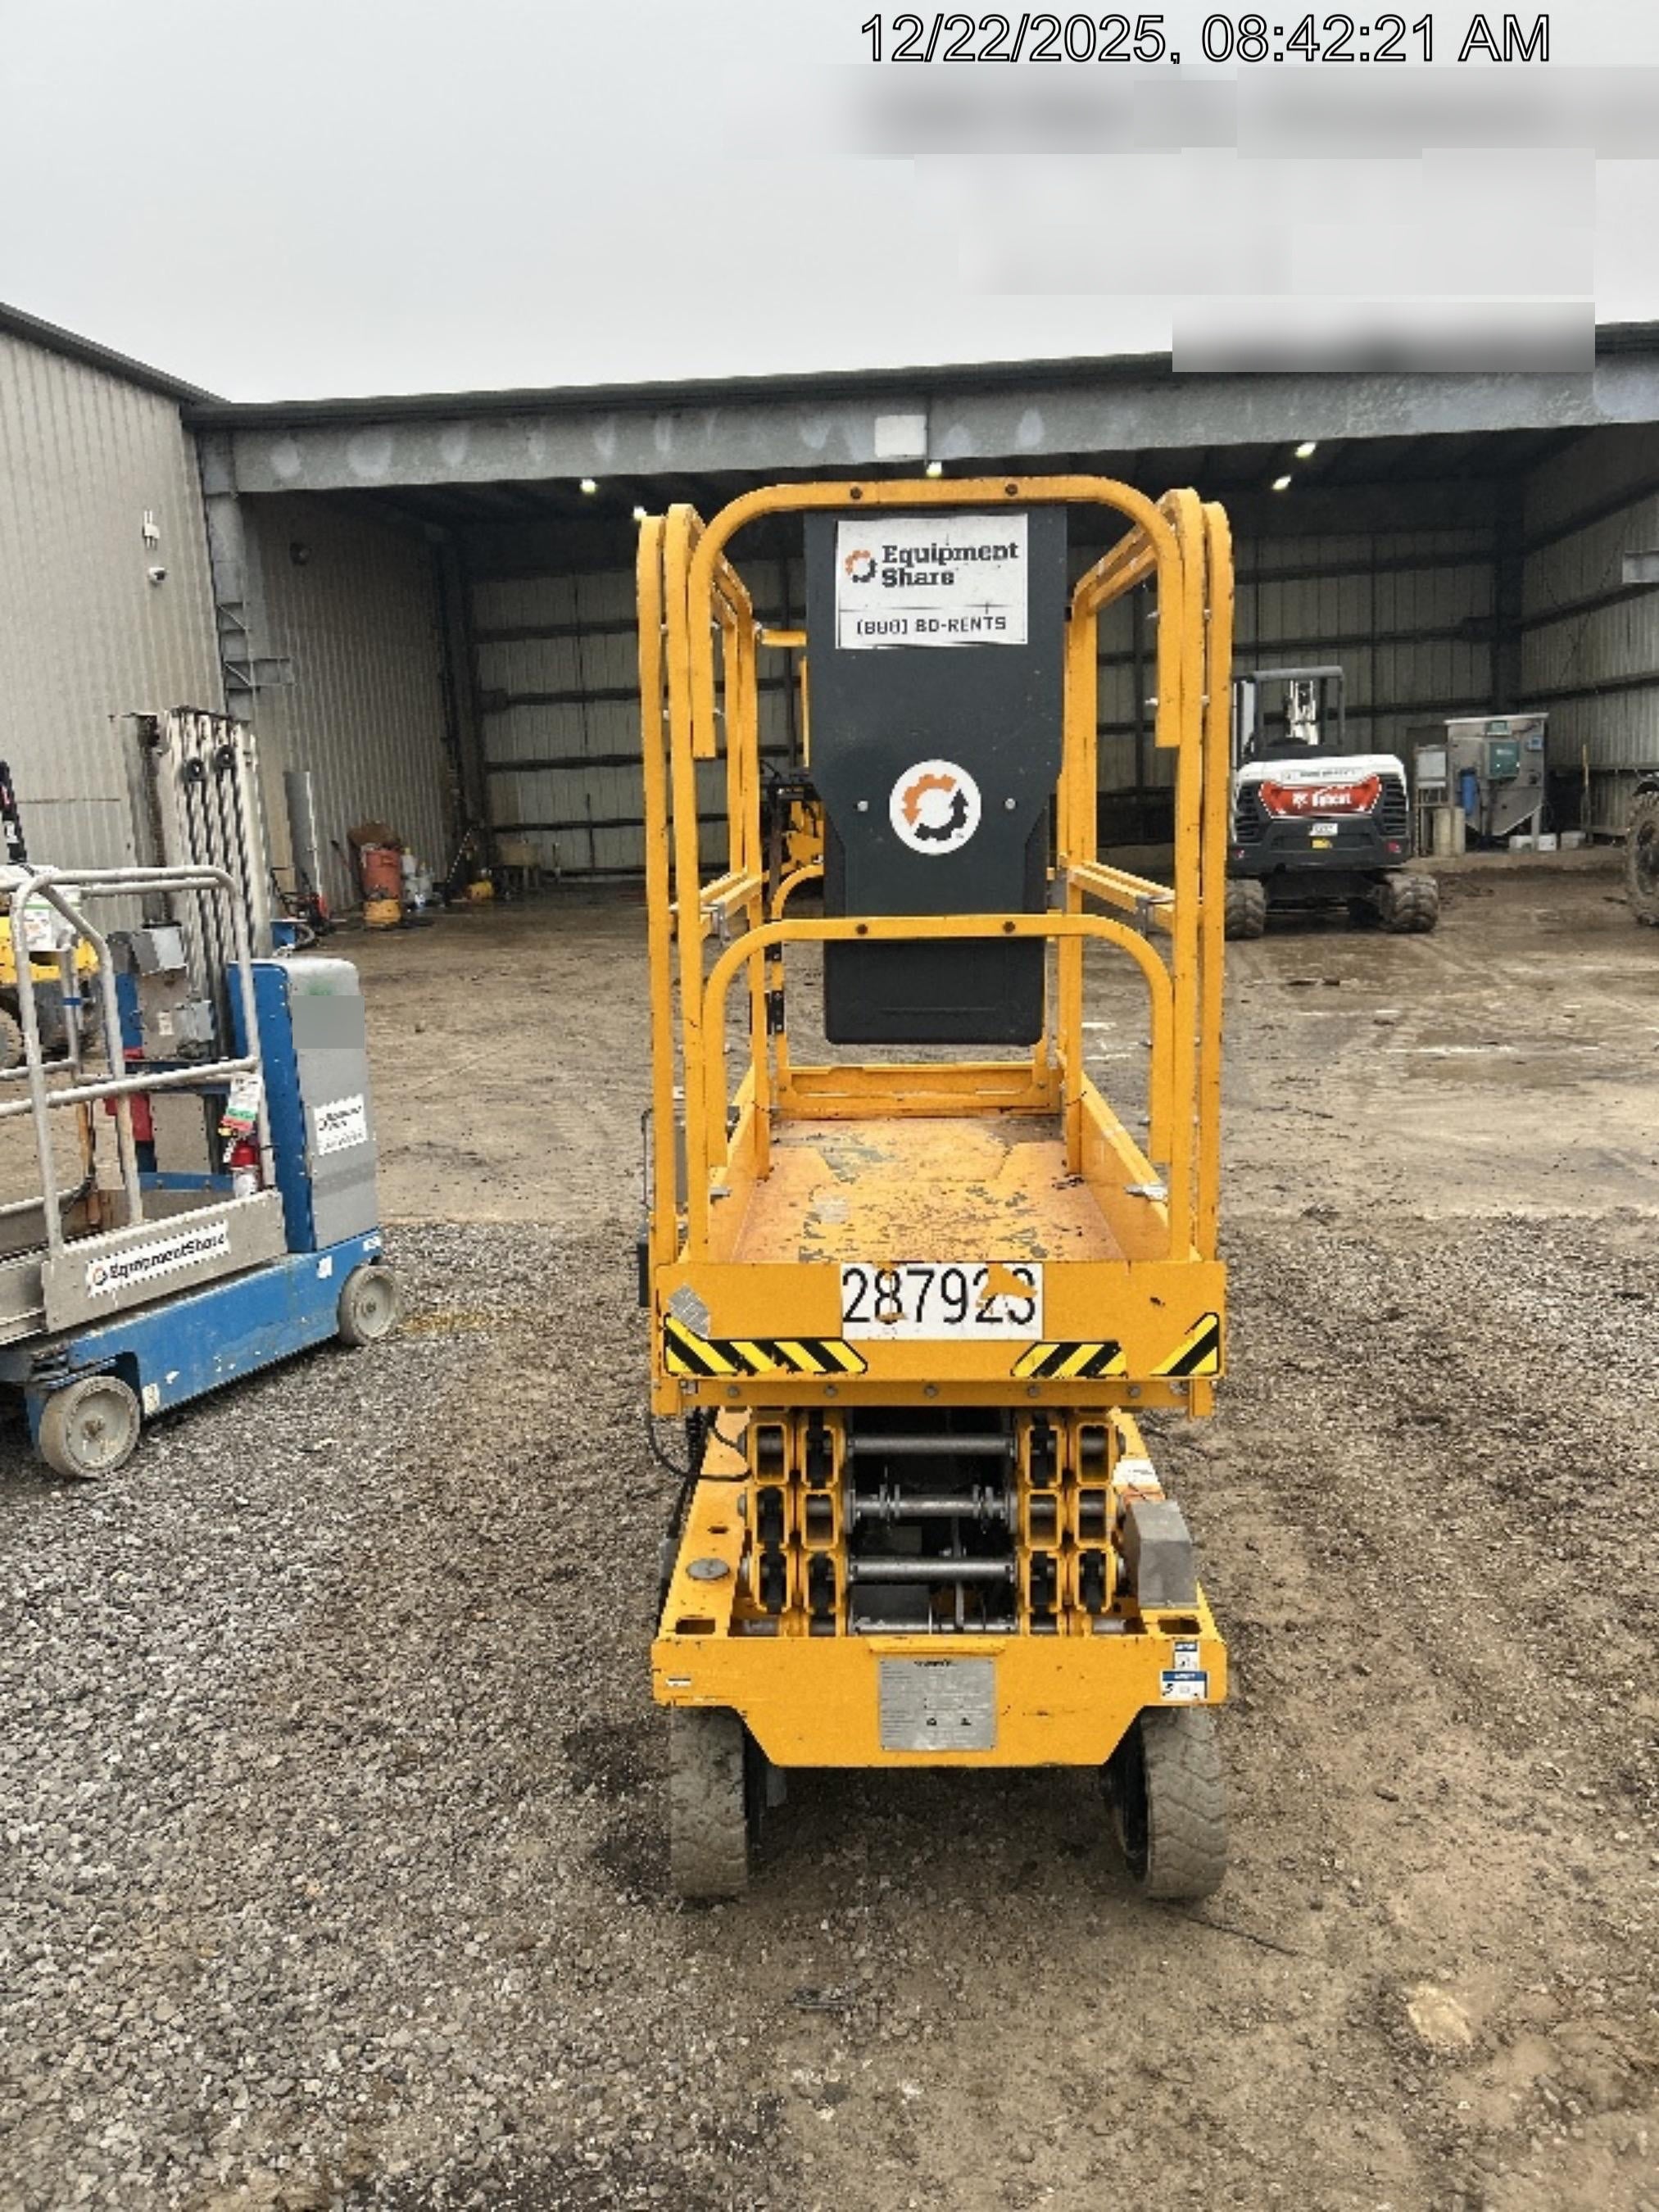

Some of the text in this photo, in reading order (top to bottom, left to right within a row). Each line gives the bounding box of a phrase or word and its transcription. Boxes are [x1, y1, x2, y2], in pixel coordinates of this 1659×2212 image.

[882, 542, 1018, 565] Equipment
[882, 568, 954, 587] Share
[842, 1267, 1036, 1325] 287923
